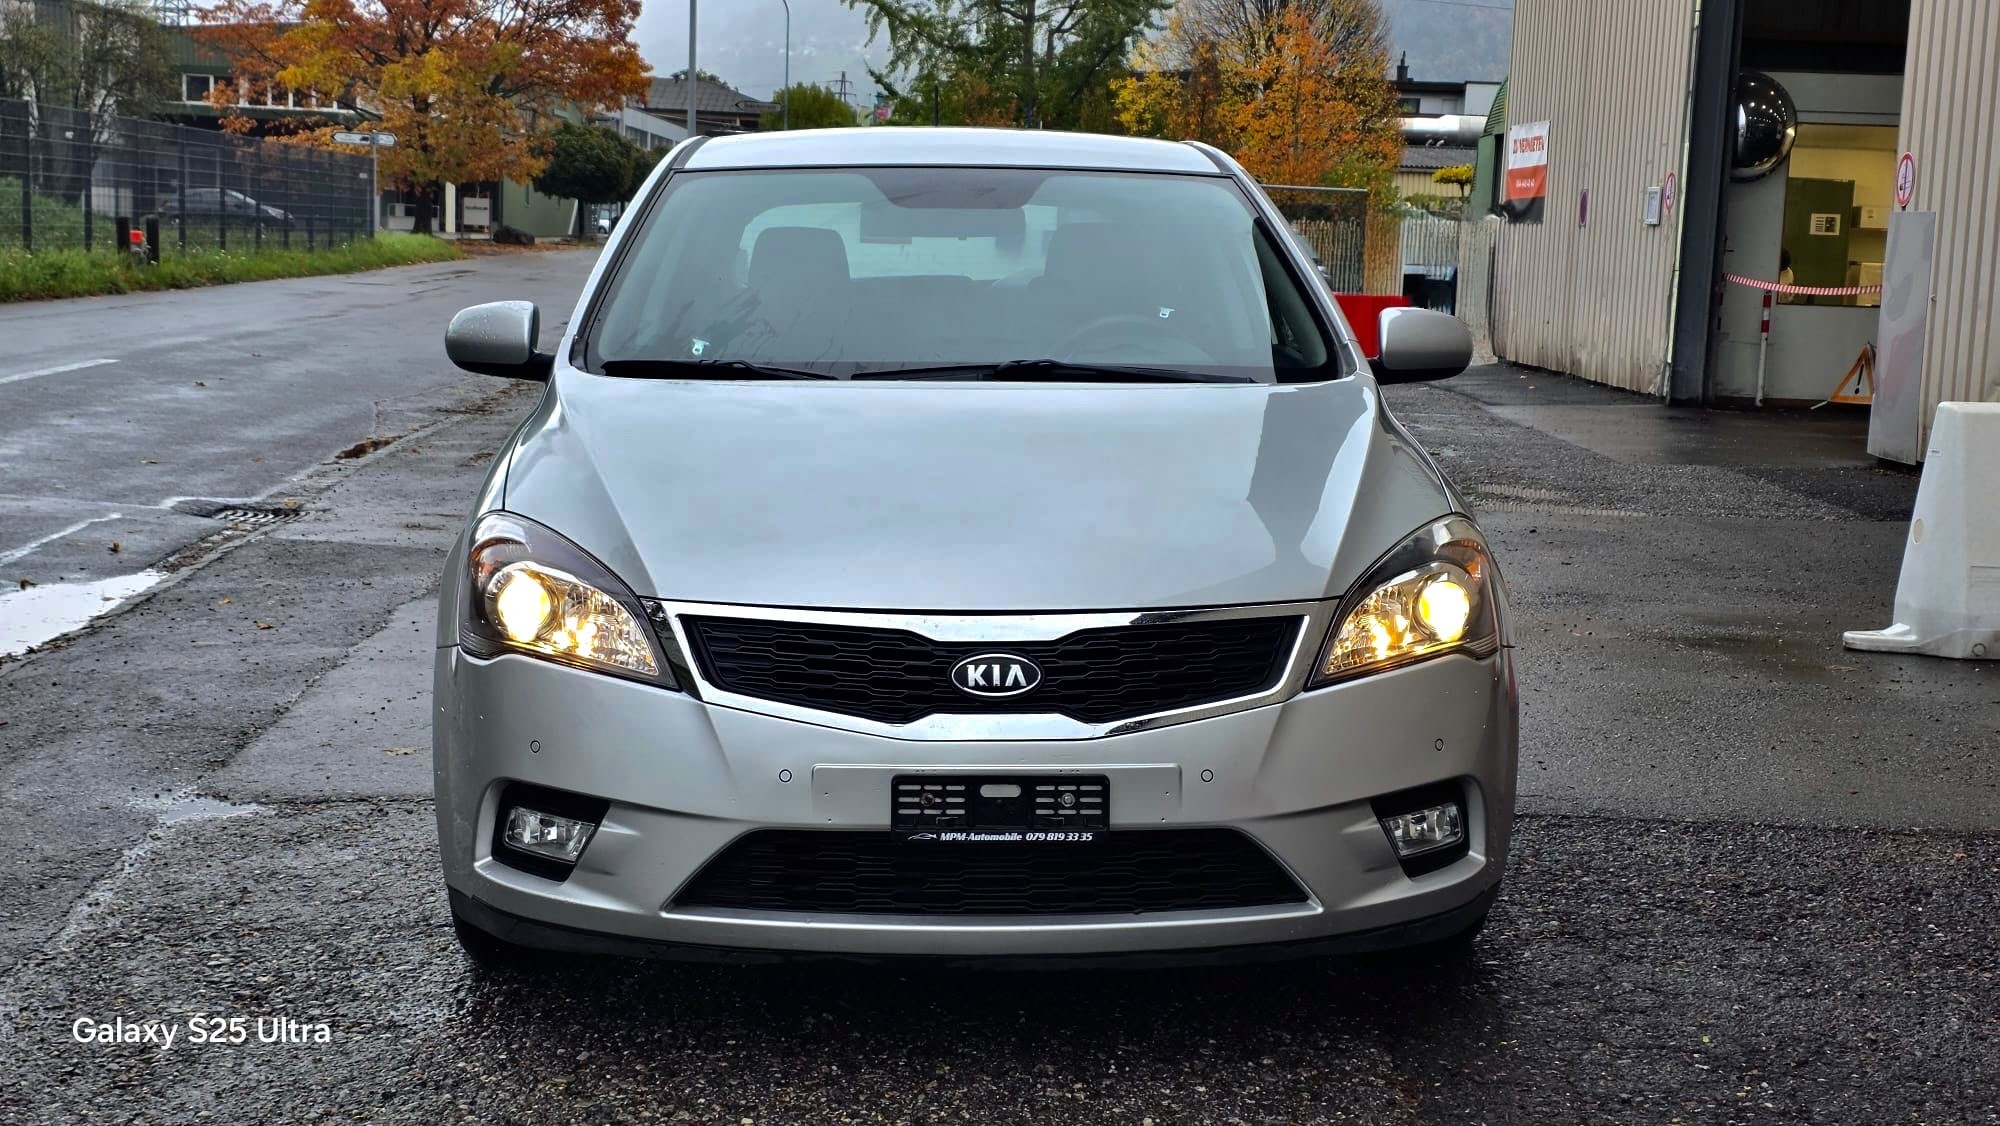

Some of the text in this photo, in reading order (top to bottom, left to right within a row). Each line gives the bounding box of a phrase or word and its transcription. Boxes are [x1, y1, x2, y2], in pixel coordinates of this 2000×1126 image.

[966, 664, 1028, 687] KIA
[940, 832, 1093, 841] MPM-Automobile 079 819 33 35
